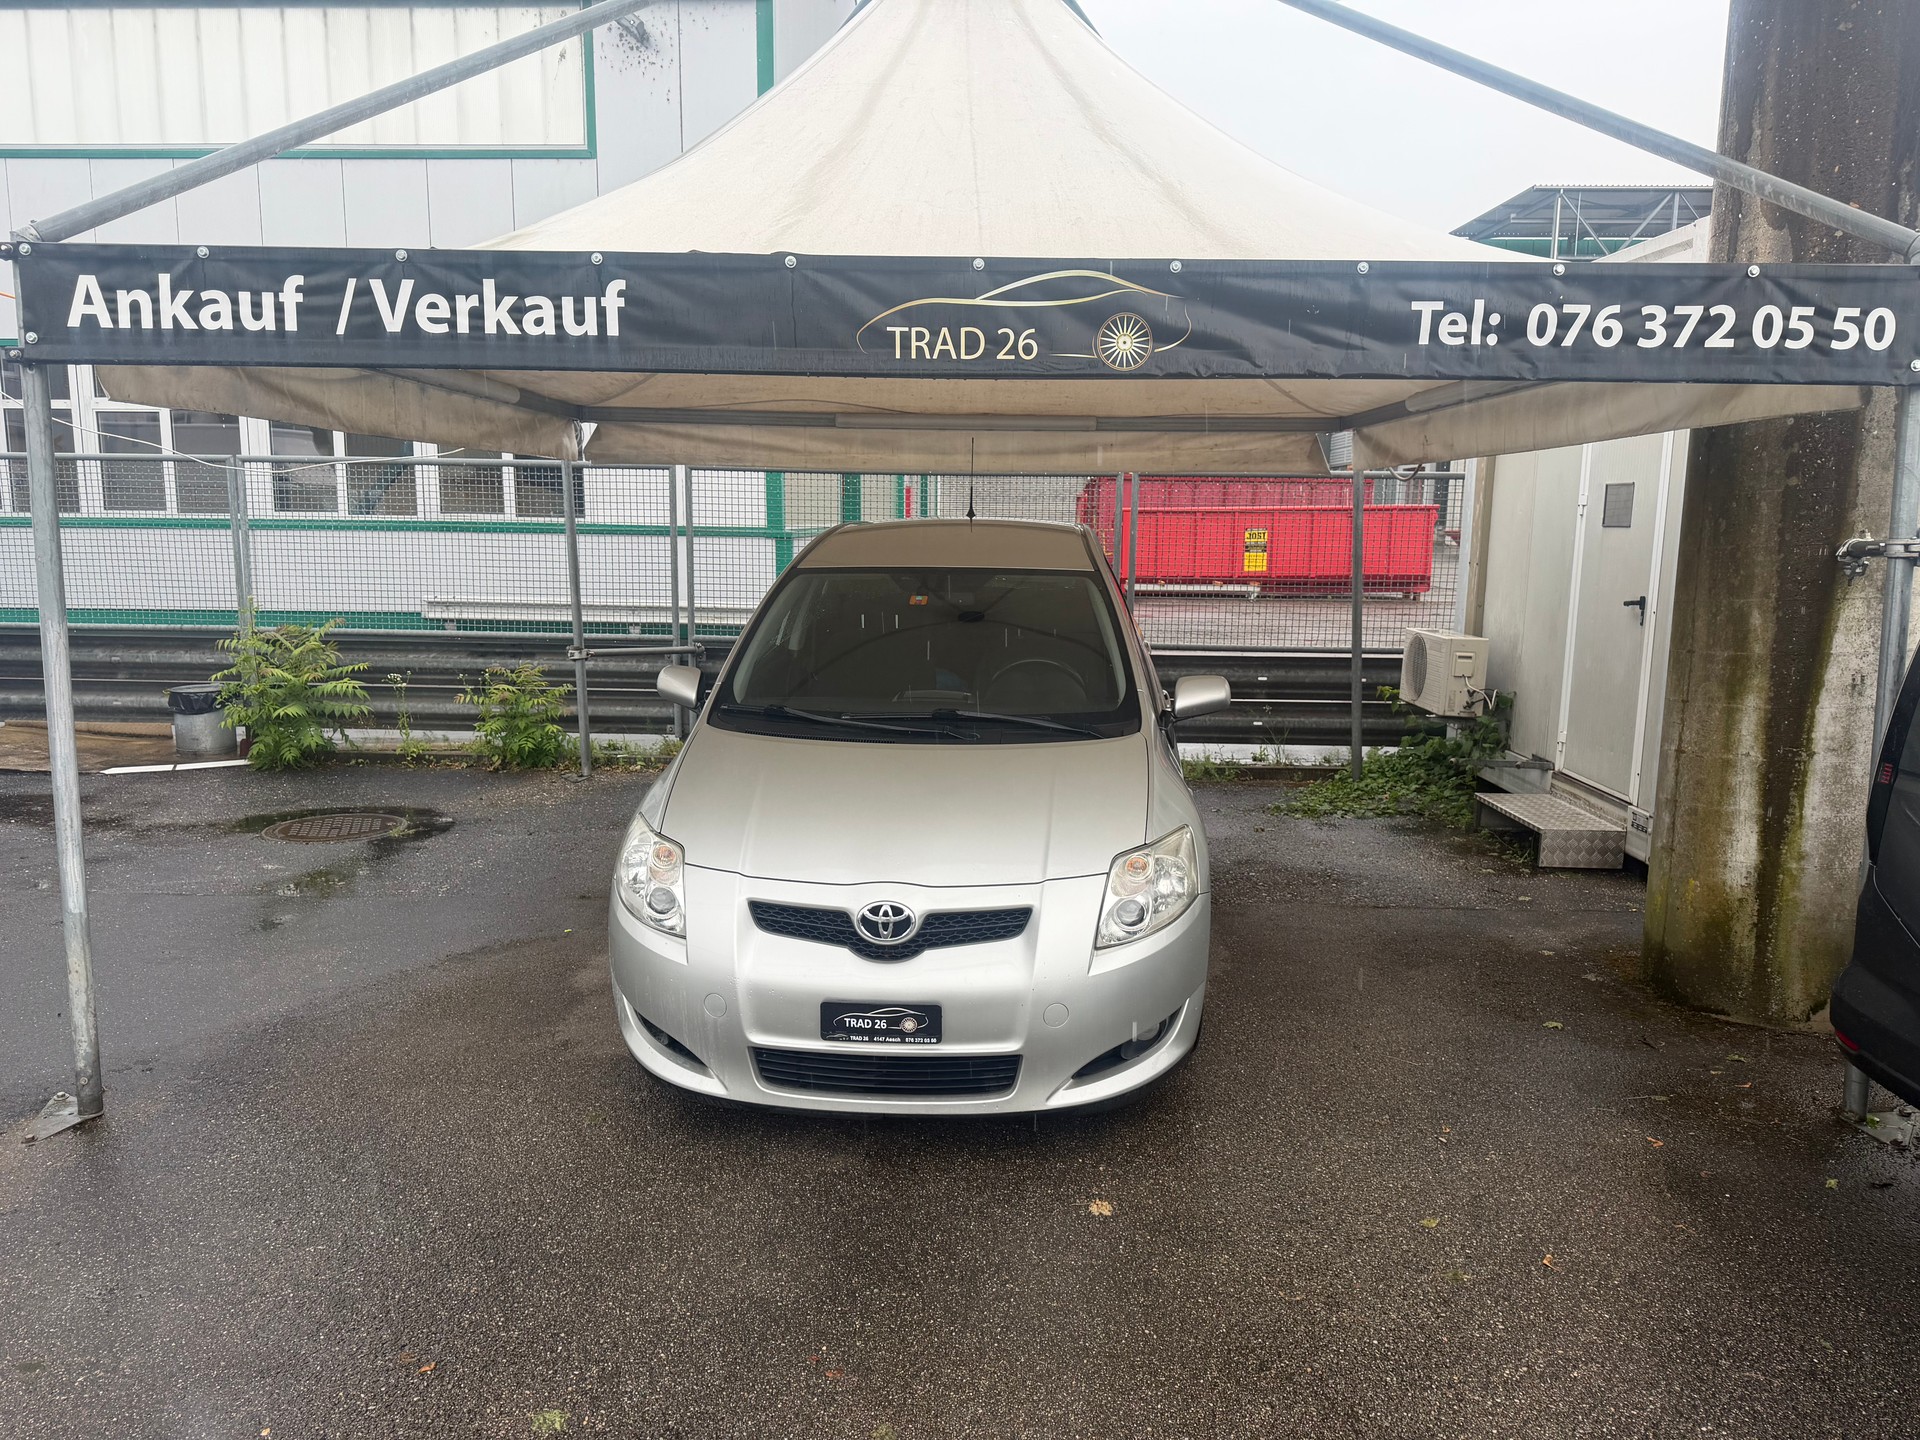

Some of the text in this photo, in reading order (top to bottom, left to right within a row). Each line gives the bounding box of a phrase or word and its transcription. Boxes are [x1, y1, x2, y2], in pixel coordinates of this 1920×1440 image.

[67, 273, 304, 332] Ankauf
[1411, 299, 1897, 351] Tel: 076 372 05 50
[886, 326, 1038, 360] TRAD 26
[1246, 532, 1267, 540] JOST
[843, 1018, 887, 1029] TRAD 26
